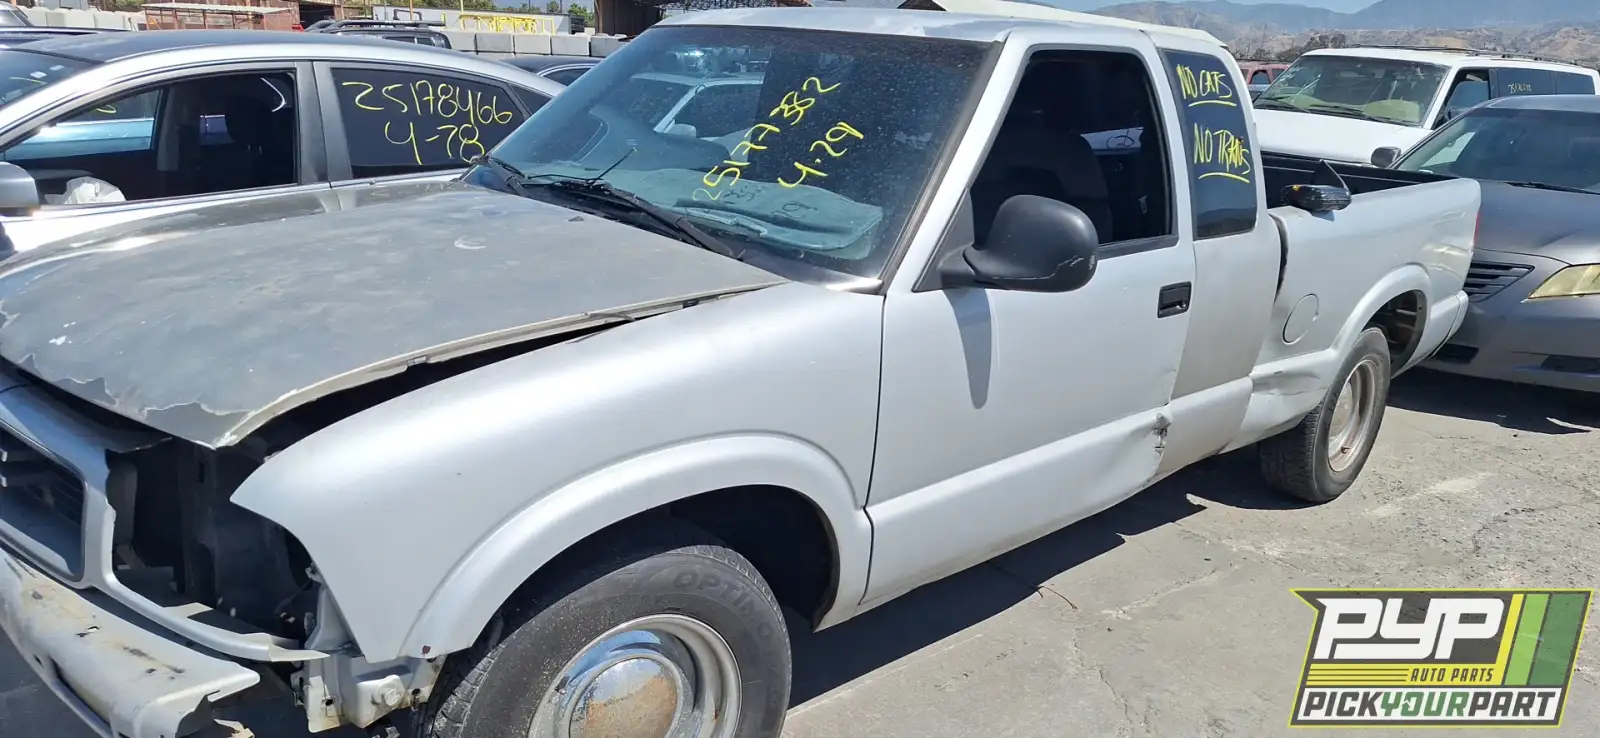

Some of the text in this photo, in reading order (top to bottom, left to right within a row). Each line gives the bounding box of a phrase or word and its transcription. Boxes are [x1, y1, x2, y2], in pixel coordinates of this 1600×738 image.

[341, 79, 513, 126] 25178466
[1176, 64, 1233, 99] NO CATS
[1193, 122, 1213, 164] NO
